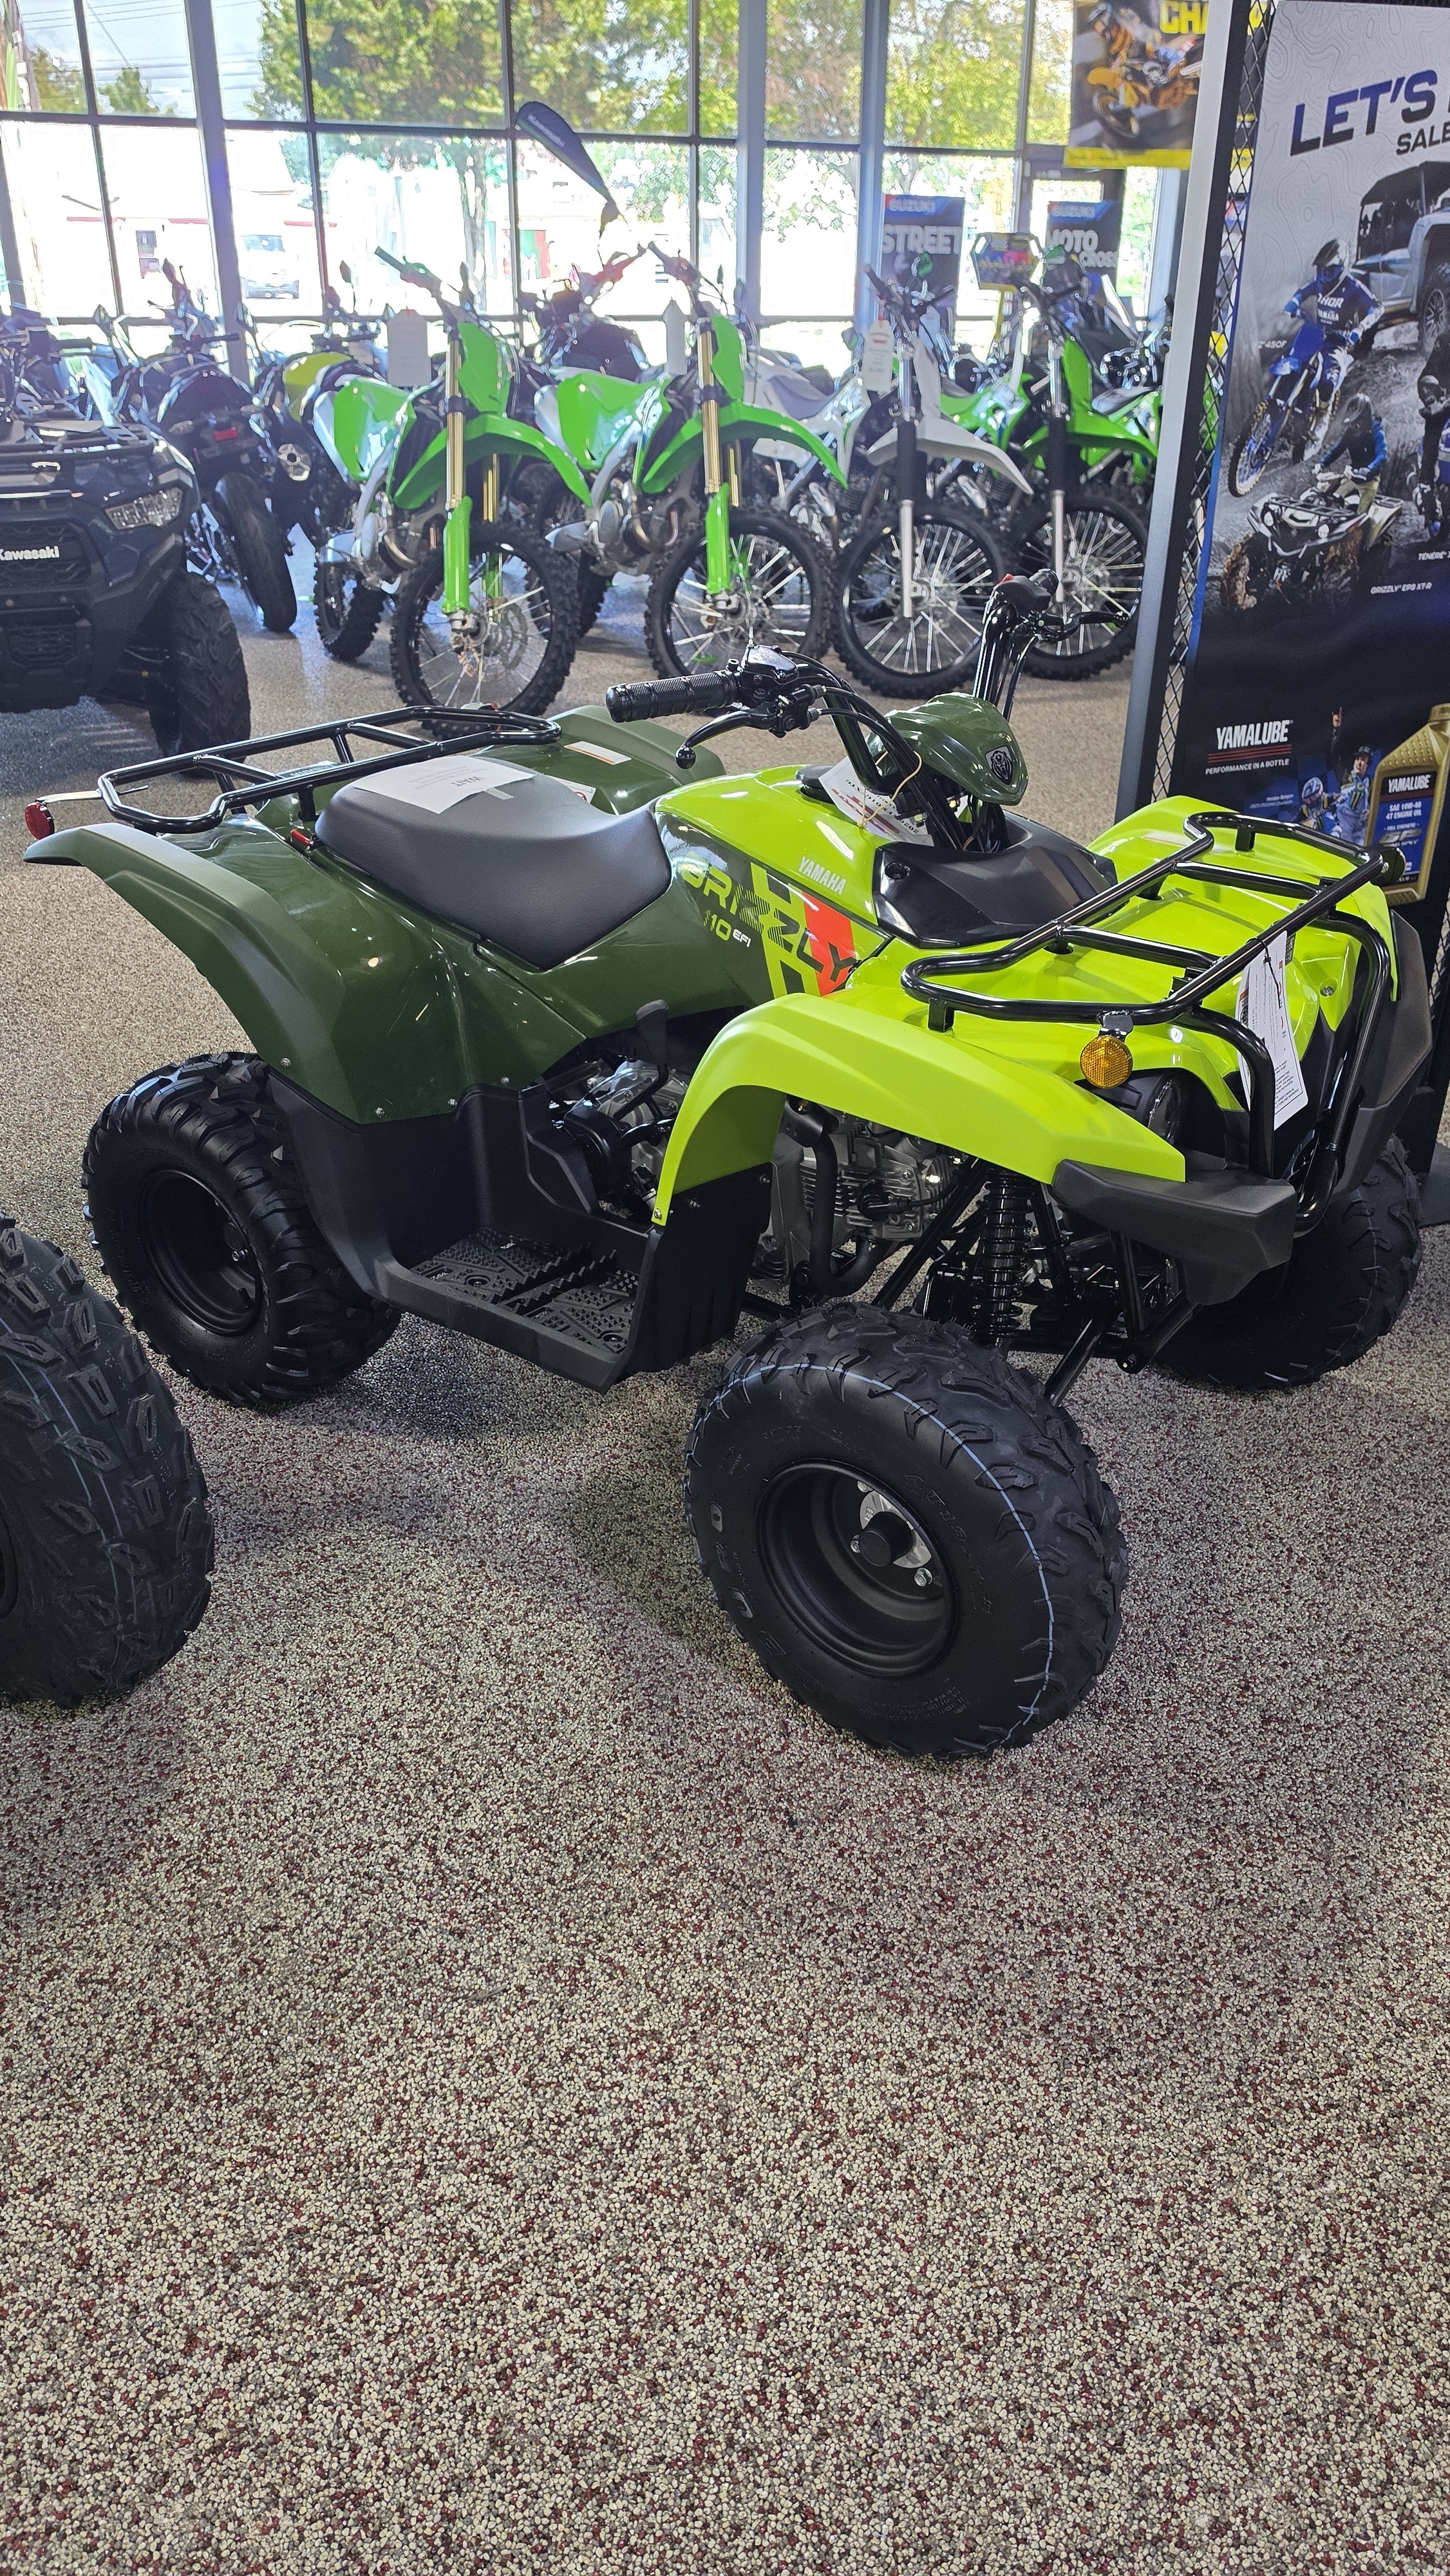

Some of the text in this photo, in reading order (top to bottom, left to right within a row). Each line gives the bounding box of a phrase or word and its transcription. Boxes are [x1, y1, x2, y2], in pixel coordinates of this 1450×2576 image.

[1290, 69, 1438, 156] LET'S
[882, 224, 961, 254] STREET
[1046, 229, 1098, 252] MOTO
[1216, 719, 1290, 750] YAMALUBE
[1205, 763, 1252, 775] PERFORMANCE
[1266, 758, 1290, 768] BOTTLE
[451, 776, 485, 787] WAIT
[1388, 774, 1431, 793] YAMALUBE
[1389, 804, 1400, 812] SAE
[798, 856, 847, 895] YAMAHA
[677, 851, 857, 983] GRIZZLY
[732, 929, 751, 947] EFI
